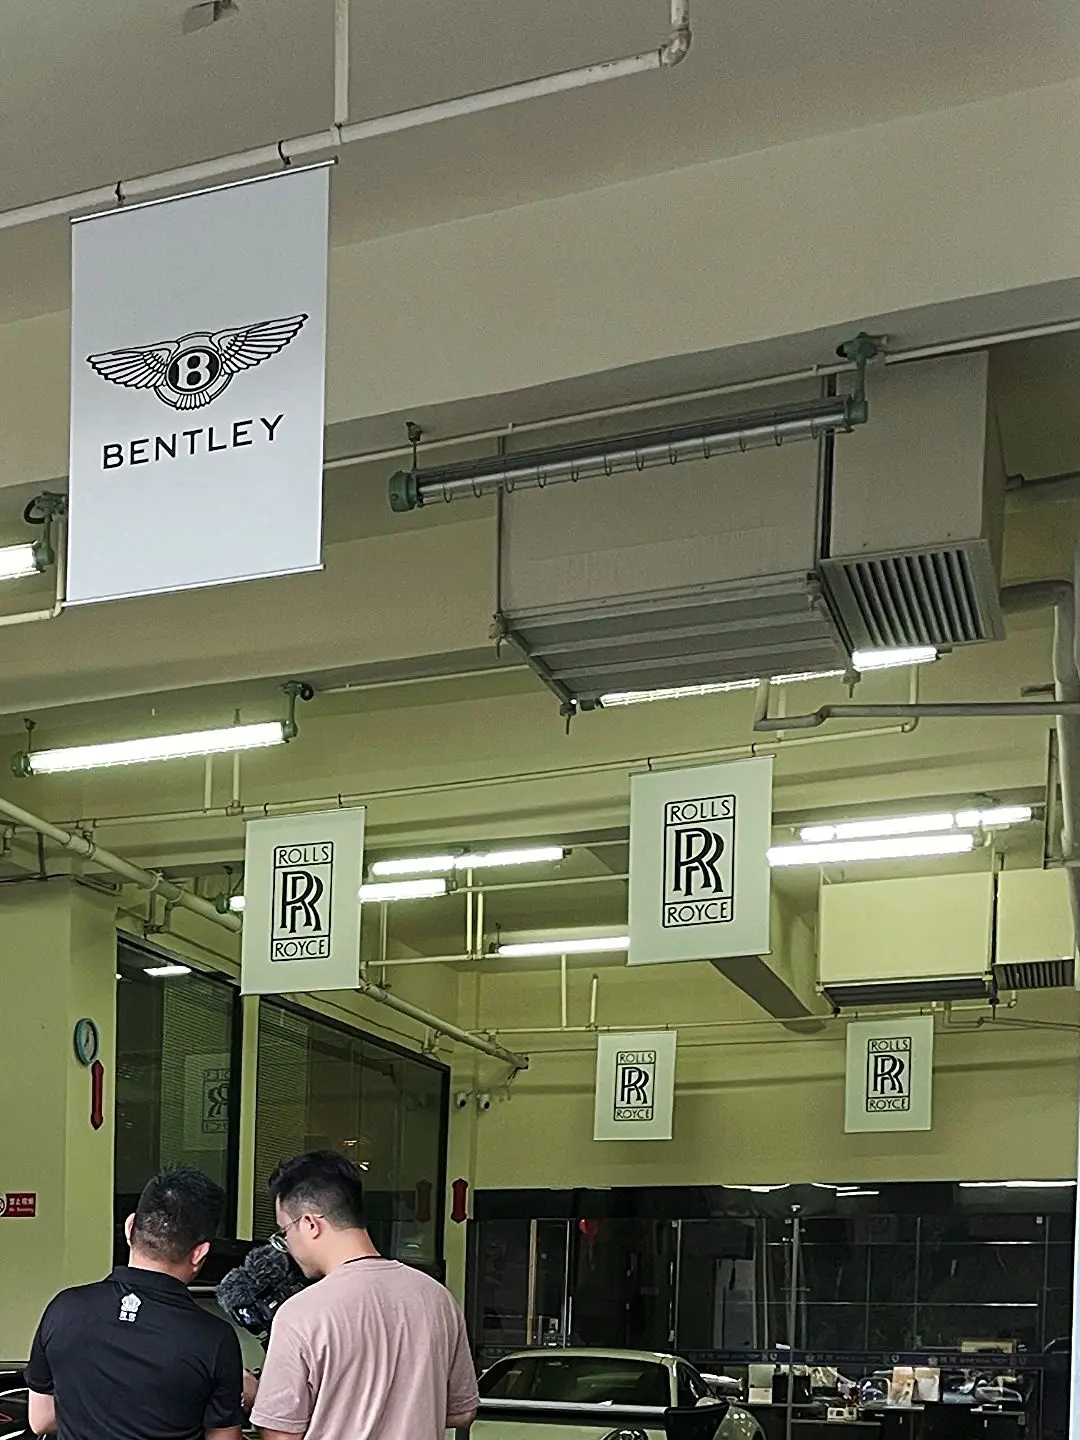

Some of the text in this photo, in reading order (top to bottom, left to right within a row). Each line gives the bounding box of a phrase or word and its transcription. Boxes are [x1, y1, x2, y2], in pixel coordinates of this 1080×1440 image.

[103, 414, 284, 469] BENTLEY
[670, 799, 730, 822] ROLLS
[278, 845, 329, 864] ROLLS
[667, 901, 728, 923] ROYCE
[275, 939, 325, 957] ROYCE
[871, 1040, 909, 1051] ROLLS
[620, 1053, 653, 1063] ROLLS
[869, 1098, 905, 1110] ROYCE
[616, 1109, 650, 1119] ROYCE
